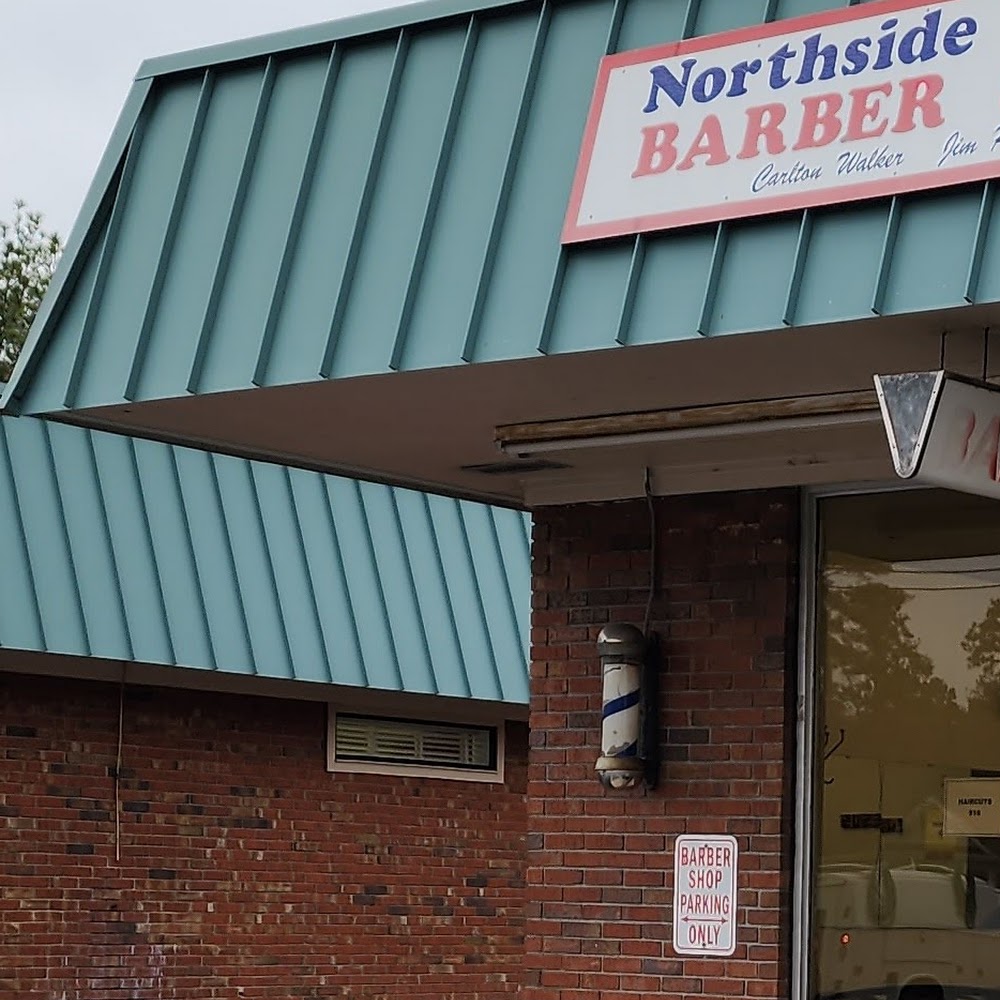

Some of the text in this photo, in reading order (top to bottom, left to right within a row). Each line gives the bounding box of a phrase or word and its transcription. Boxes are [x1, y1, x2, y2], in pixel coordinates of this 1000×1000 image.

[643, 8, 978, 113] Northside
[631, 74, 945, 179] BARBER
[752, 162, 823, 192] Carlton
[837, 145, 904, 176] Walker
[938, 132, 978, 167] Jim
[681, 847, 731, 867] BARBER
[688, 869, 723, 889] SHOP
[680, 894, 730, 915] PARKING
[688, 924, 721, 945] ONLY
